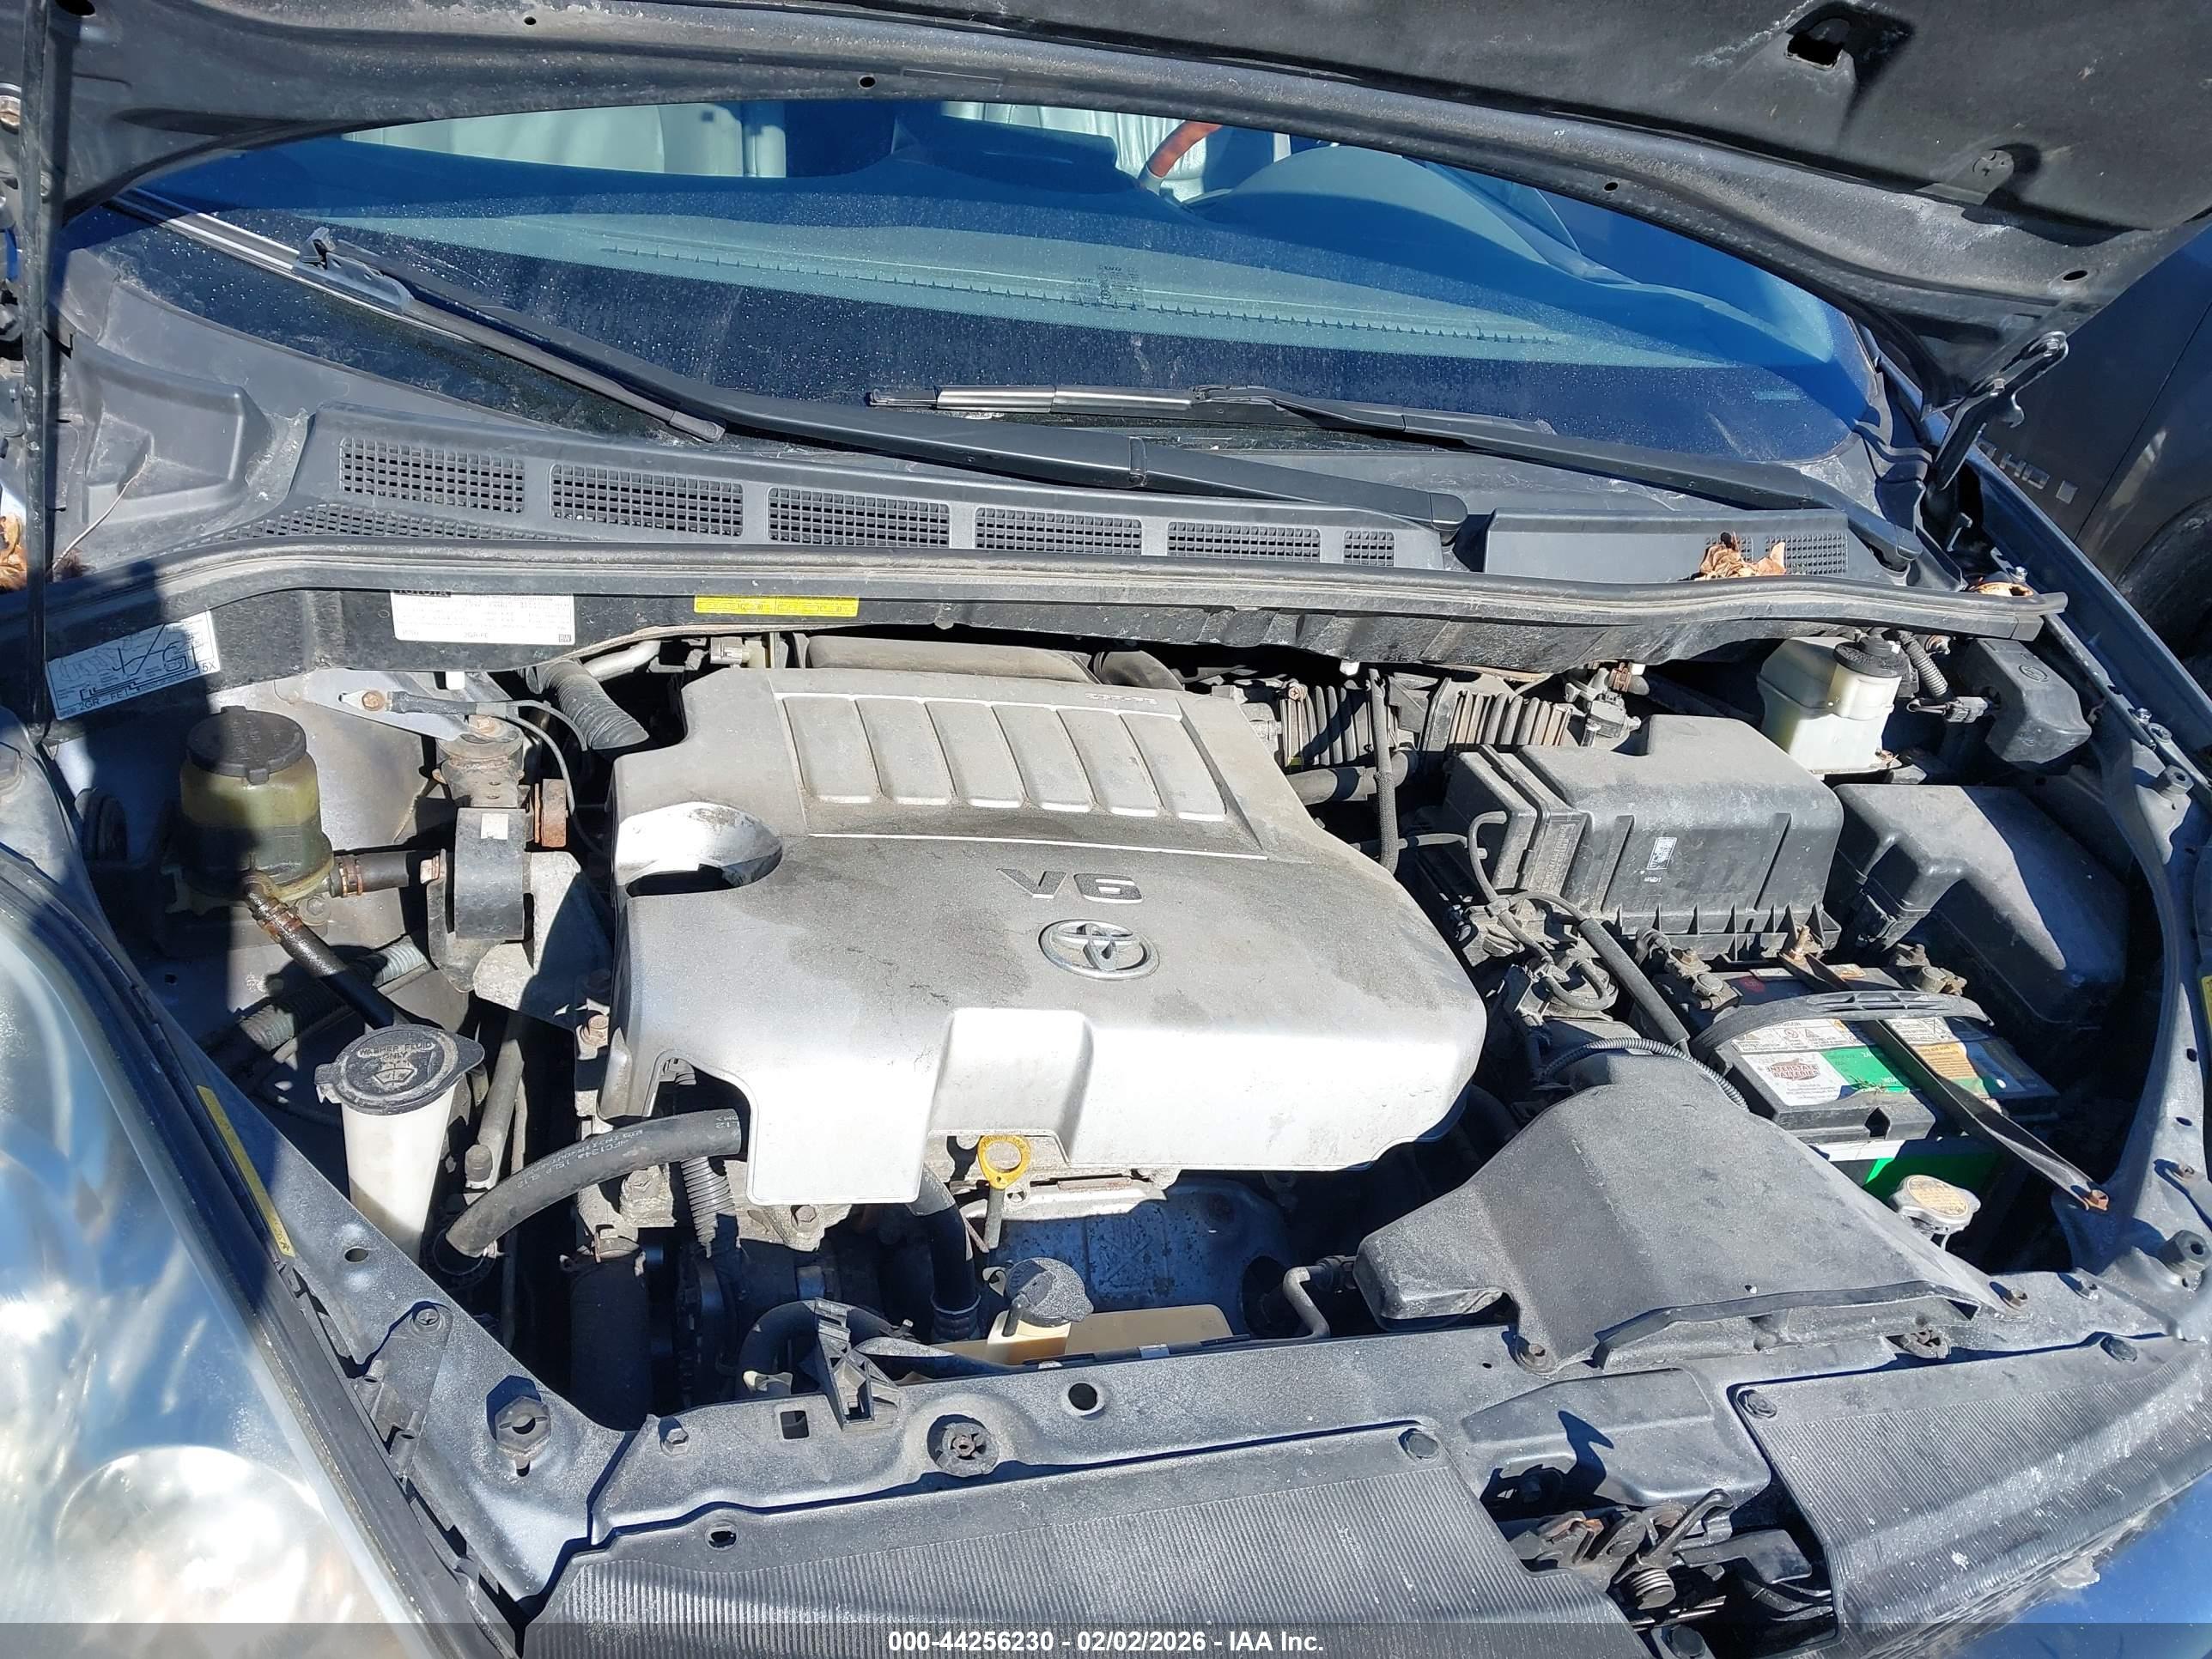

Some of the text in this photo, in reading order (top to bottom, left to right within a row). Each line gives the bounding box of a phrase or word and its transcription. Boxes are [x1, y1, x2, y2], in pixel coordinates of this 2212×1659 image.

[202, 660, 216, 673] 5X
[995, 868, 1144, 904] V6
[358, 1045, 400, 1056] WASHER
[381, 1051, 409, 1060] ONLY
[1765, 1064, 1820, 1073] INTERSTATE
[1773, 1070, 1821, 1079] BATTERIES
